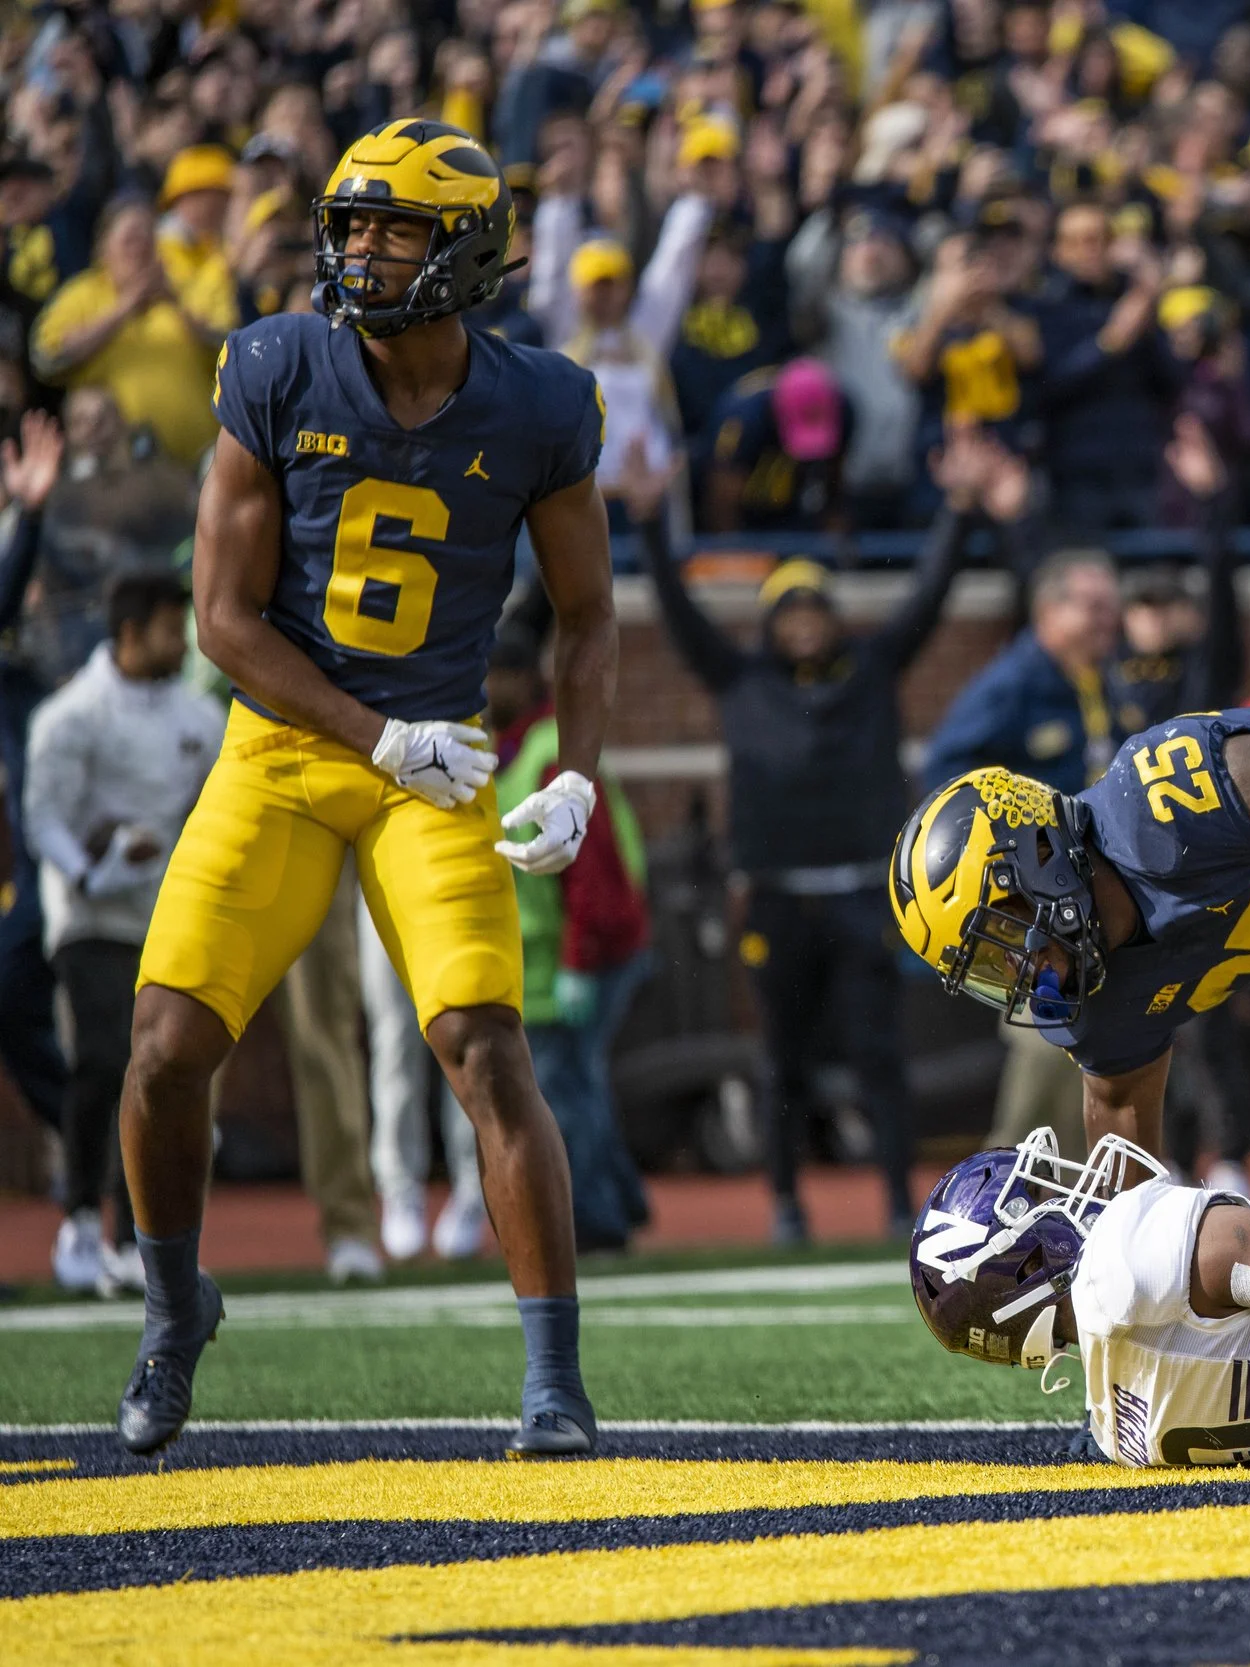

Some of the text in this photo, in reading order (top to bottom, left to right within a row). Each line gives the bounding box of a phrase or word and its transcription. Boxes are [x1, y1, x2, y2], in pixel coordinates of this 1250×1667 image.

[323, 476, 450, 657] 6
[1133, 735, 1221, 823] 25
[917, 1208, 990, 1283] N
